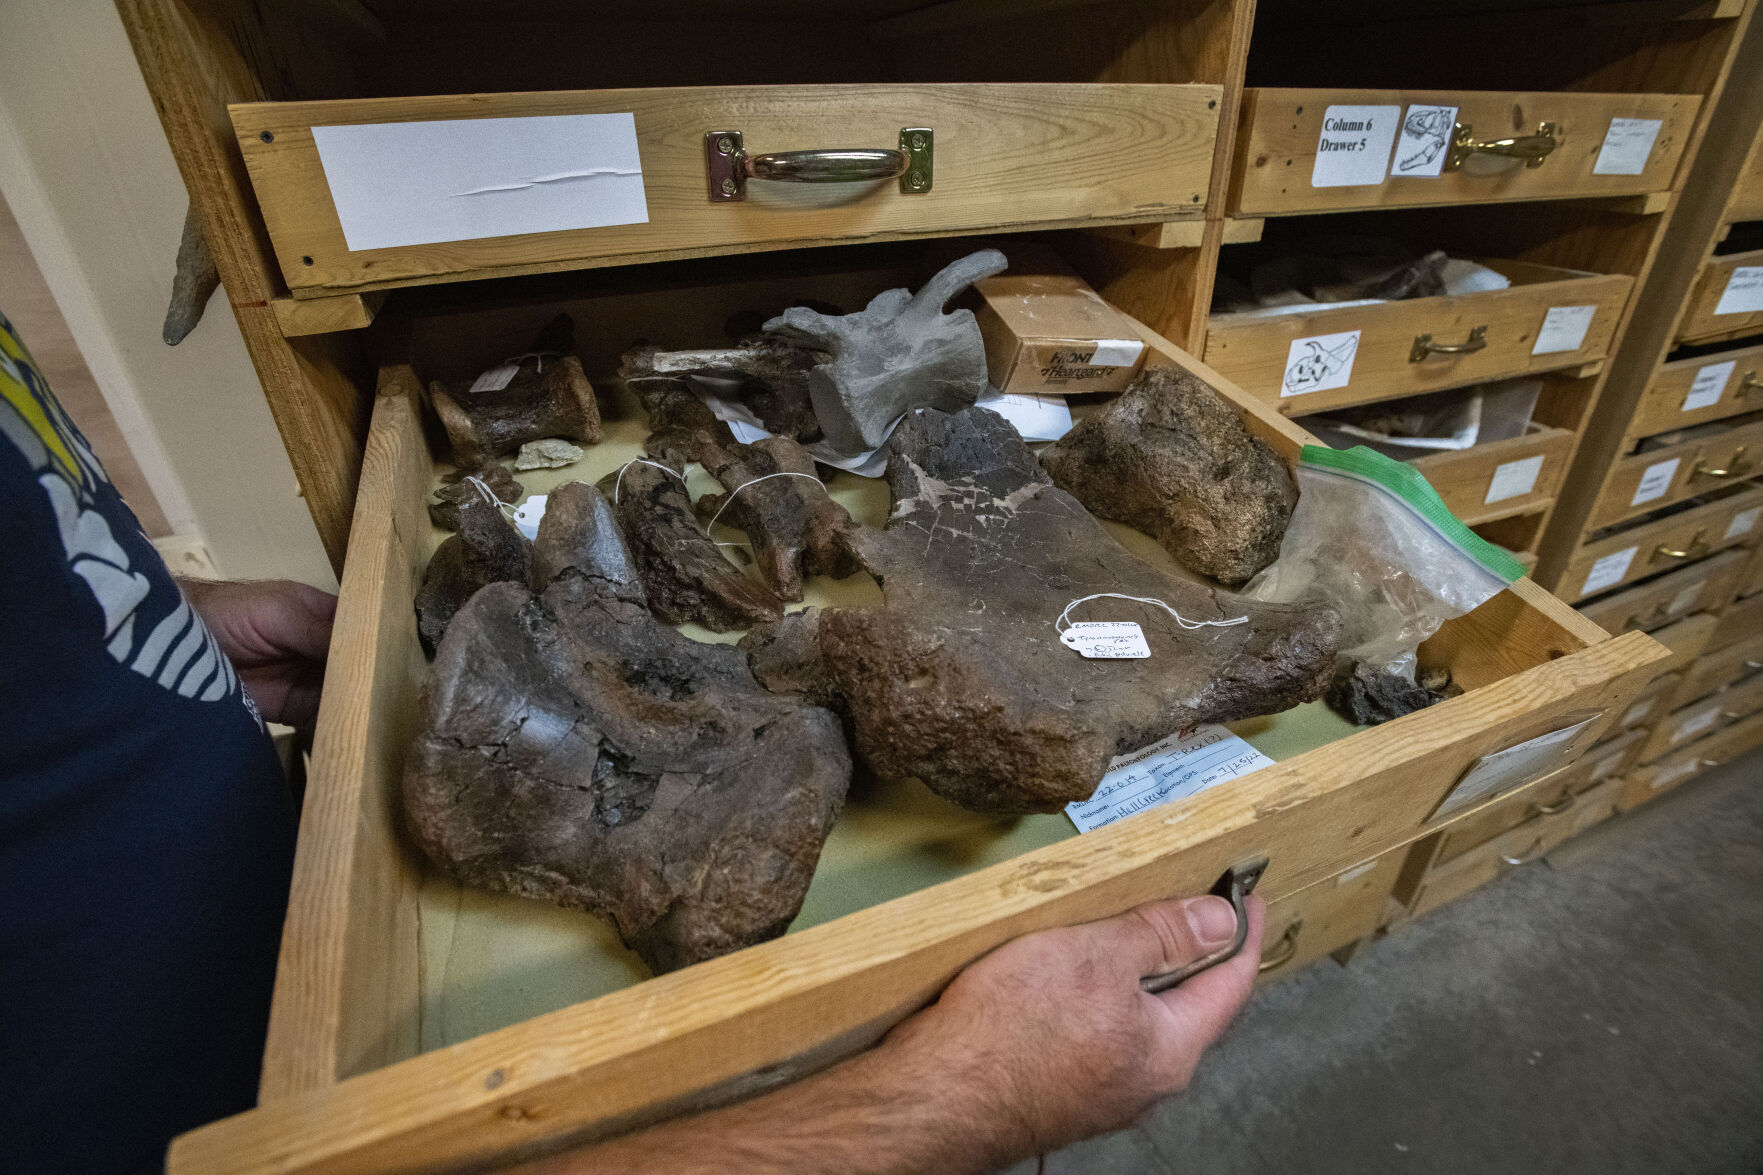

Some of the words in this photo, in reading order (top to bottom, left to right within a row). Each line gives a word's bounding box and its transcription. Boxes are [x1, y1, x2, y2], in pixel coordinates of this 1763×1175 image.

[1324, 117, 1364, 131] Column
[1366, 118, 1374, 131] 6
[1320, 138, 1358, 152] Drawer
[1359, 138, 1366, 151] 5
[1116, 746, 1160, 770] PALEONTOLOGY
[1201, 774, 1218, 785] Date:
[1080, 804, 1110, 819] Nickname:
[1089, 815, 1119, 831] Formation:
